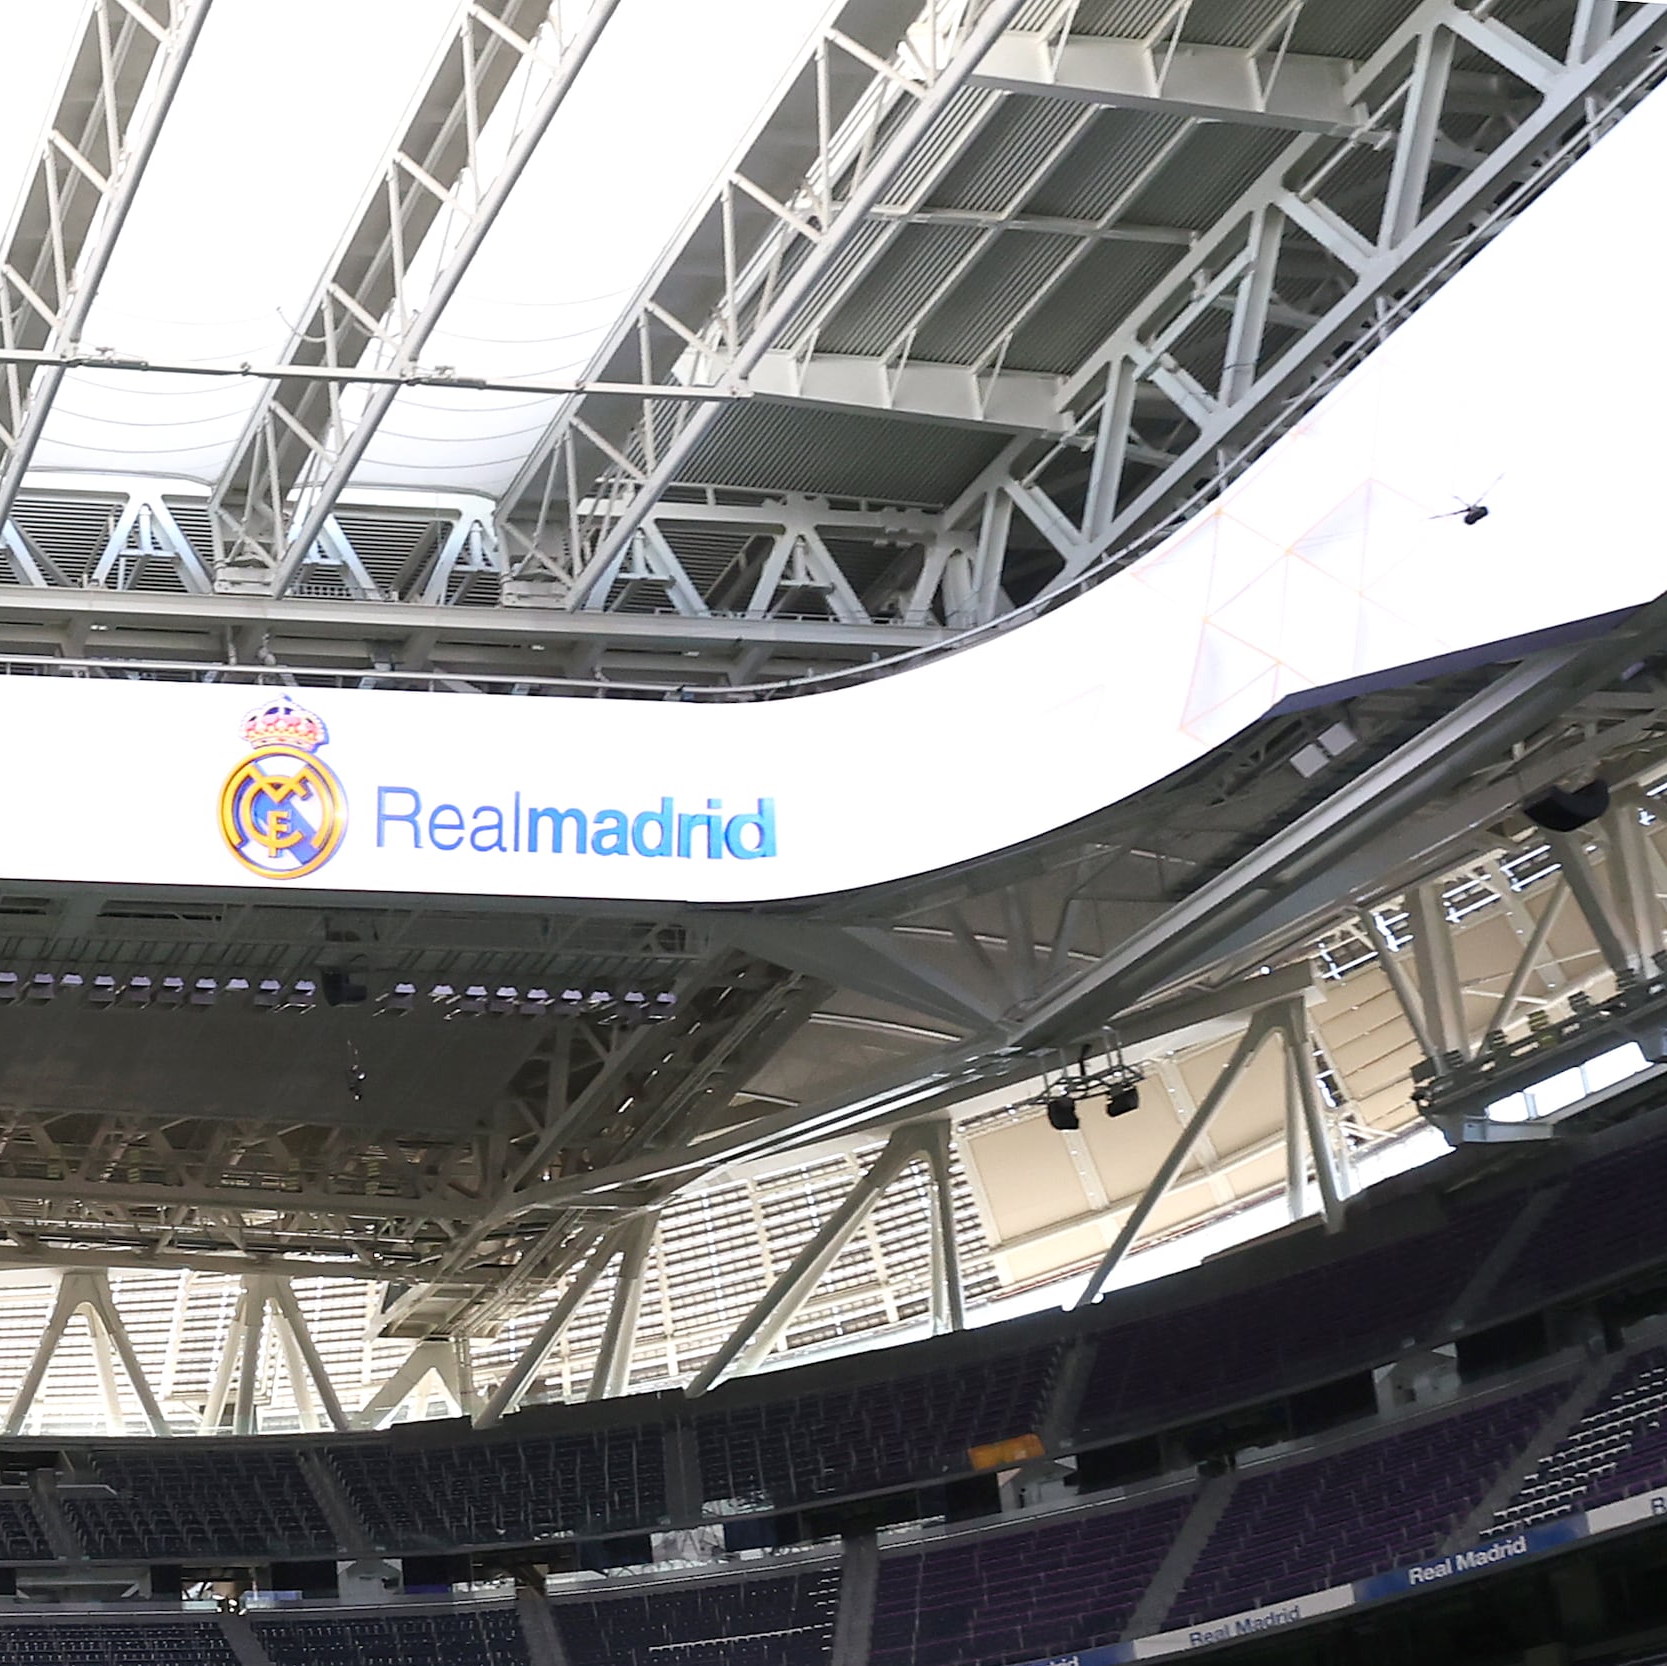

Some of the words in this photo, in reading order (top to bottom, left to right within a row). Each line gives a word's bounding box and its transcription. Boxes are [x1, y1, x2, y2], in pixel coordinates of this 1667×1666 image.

[376, 785, 777, 859] Realmadrid
[1409, 1558, 1453, 1585] Real
[1455, 1535, 1527, 1571] Madrid
